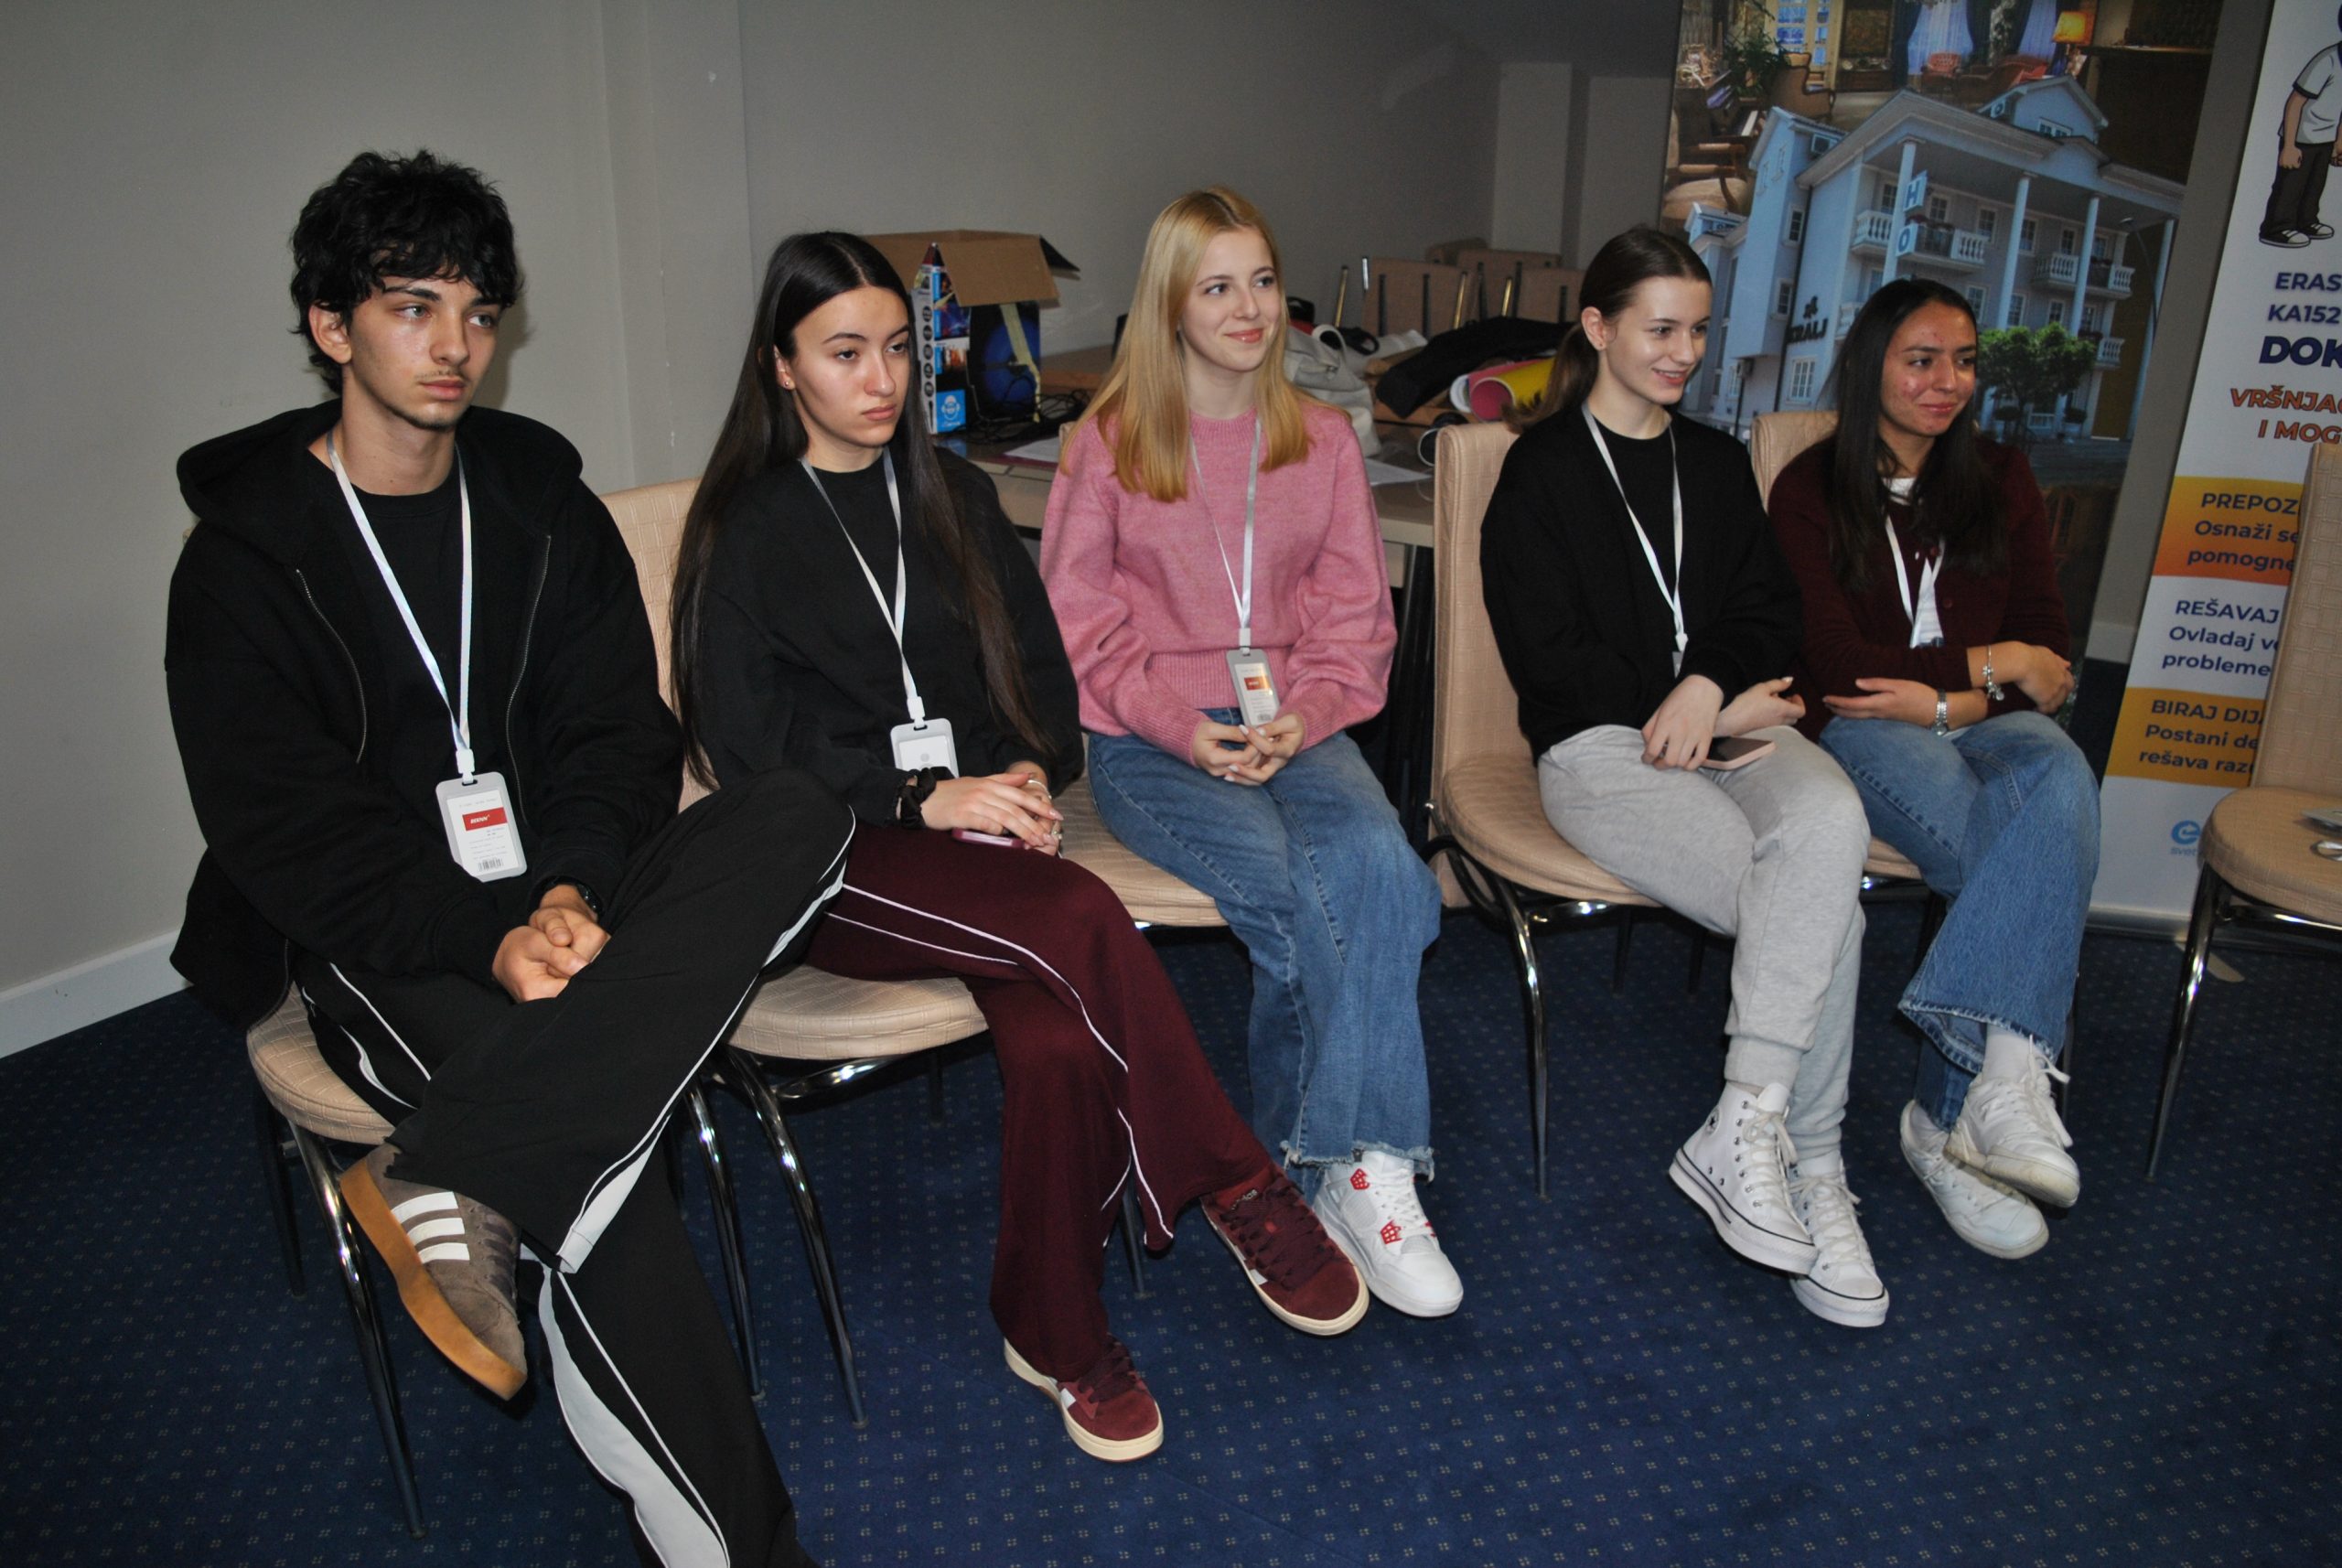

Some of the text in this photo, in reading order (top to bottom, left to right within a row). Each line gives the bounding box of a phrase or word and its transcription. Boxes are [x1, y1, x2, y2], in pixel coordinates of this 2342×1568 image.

[2274, 272, 2342, 292] ERAS
[2268, 304, 2342, 324] KA152
[2259, 335, 2342, 368] DOK
[2230, 384, 2342, 413] VRŠNJA
[2257, 419, 2269, 438] I
[2201, 492, 2299, 515] PREPOZ
[2195, 520, 2272, 541] Osnaži
[2175, 597, 2280, 624] REŠAVAJ
[2169, 626, 2255, 651] Ovladaj
[2162, 654, 2272, 677] probleme
[2151, 699, 2264, 725] BIRAJ DIJ
[2145, 724, 2229, 747] Postani
[2139, 750, 2209, 770] rešava
